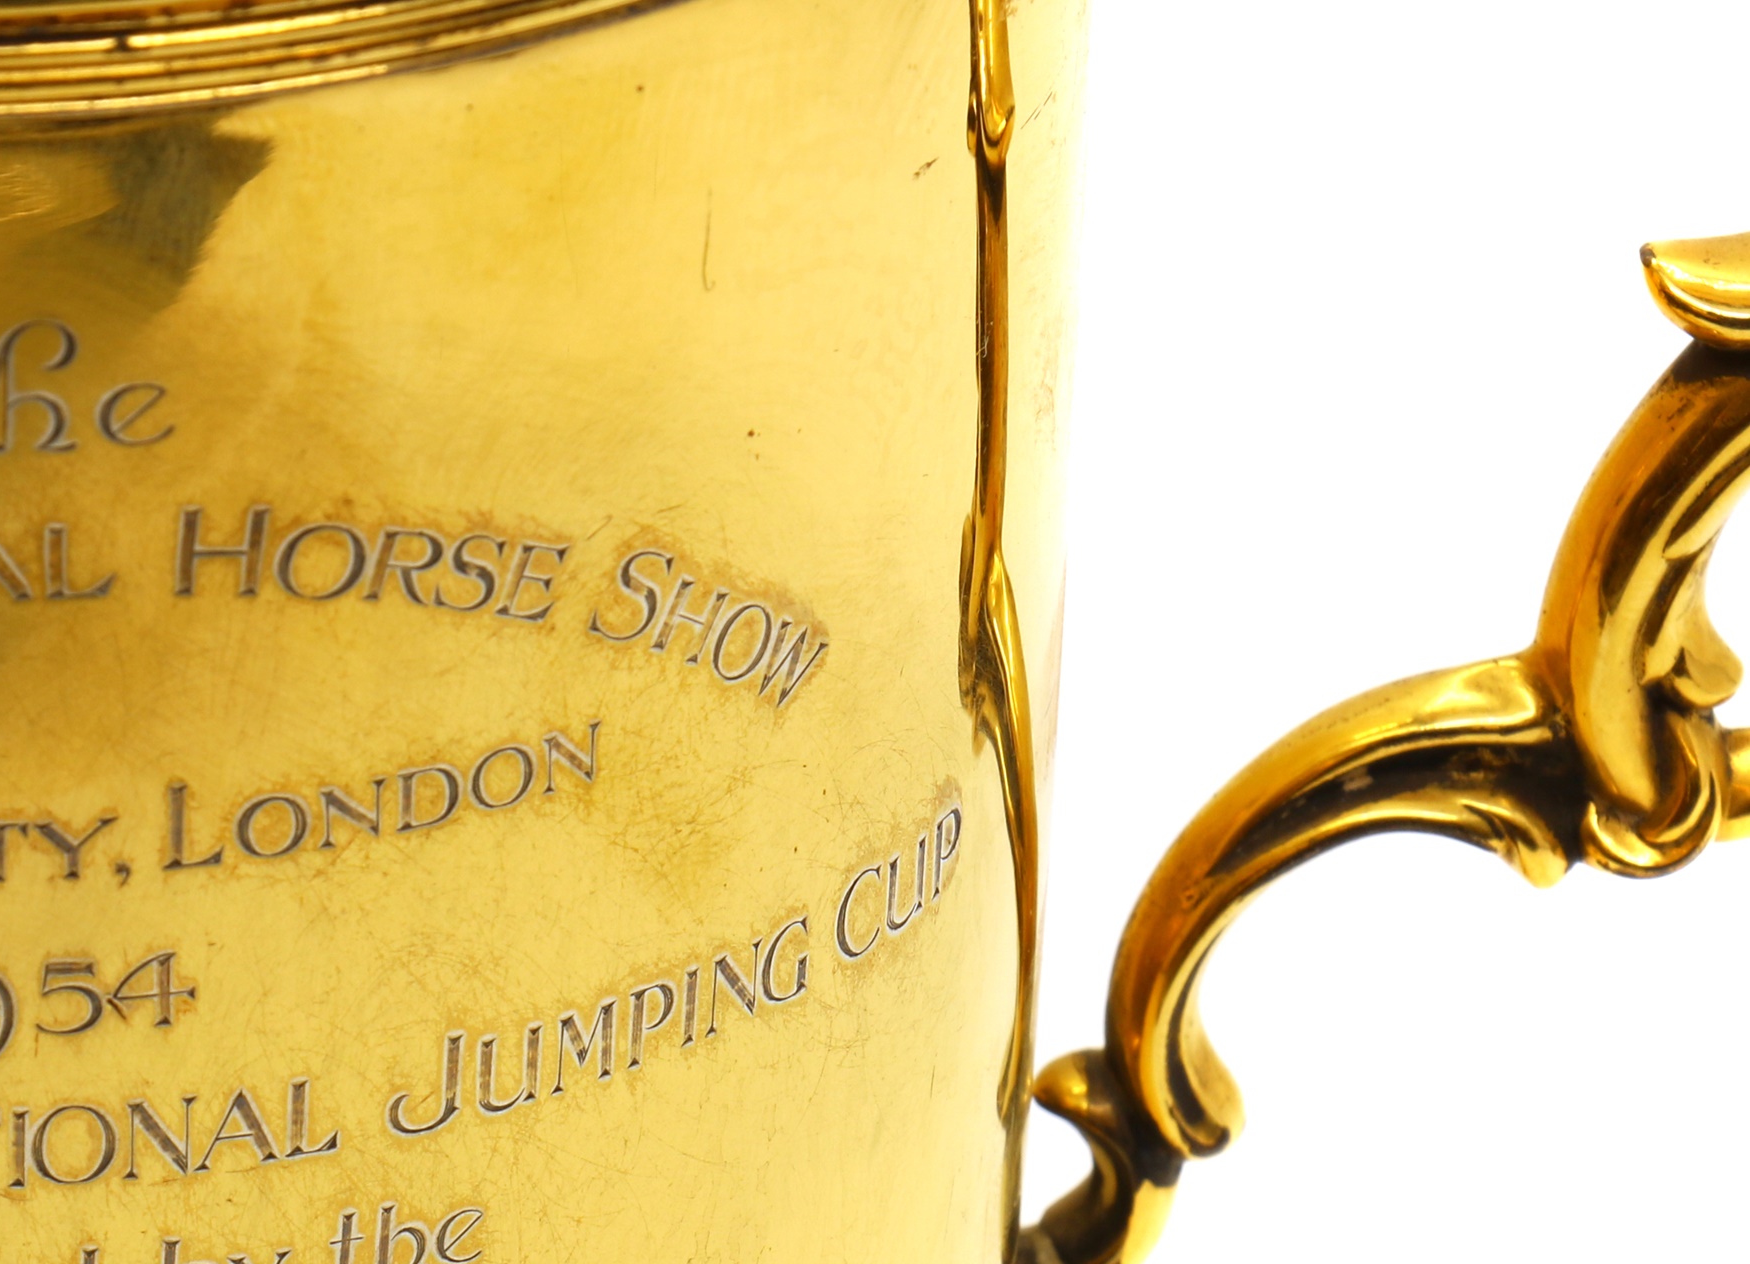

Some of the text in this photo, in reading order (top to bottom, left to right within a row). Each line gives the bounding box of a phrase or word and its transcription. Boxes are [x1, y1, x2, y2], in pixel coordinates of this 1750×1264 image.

[172, 506, 570, 622] HORSE
[587, 549, 830, 709] SHOW
[162, 721, 603, 870] LONDON
[386, 916, 809, 1137] JUMPING
[834, 801, 962, 961] CUP
